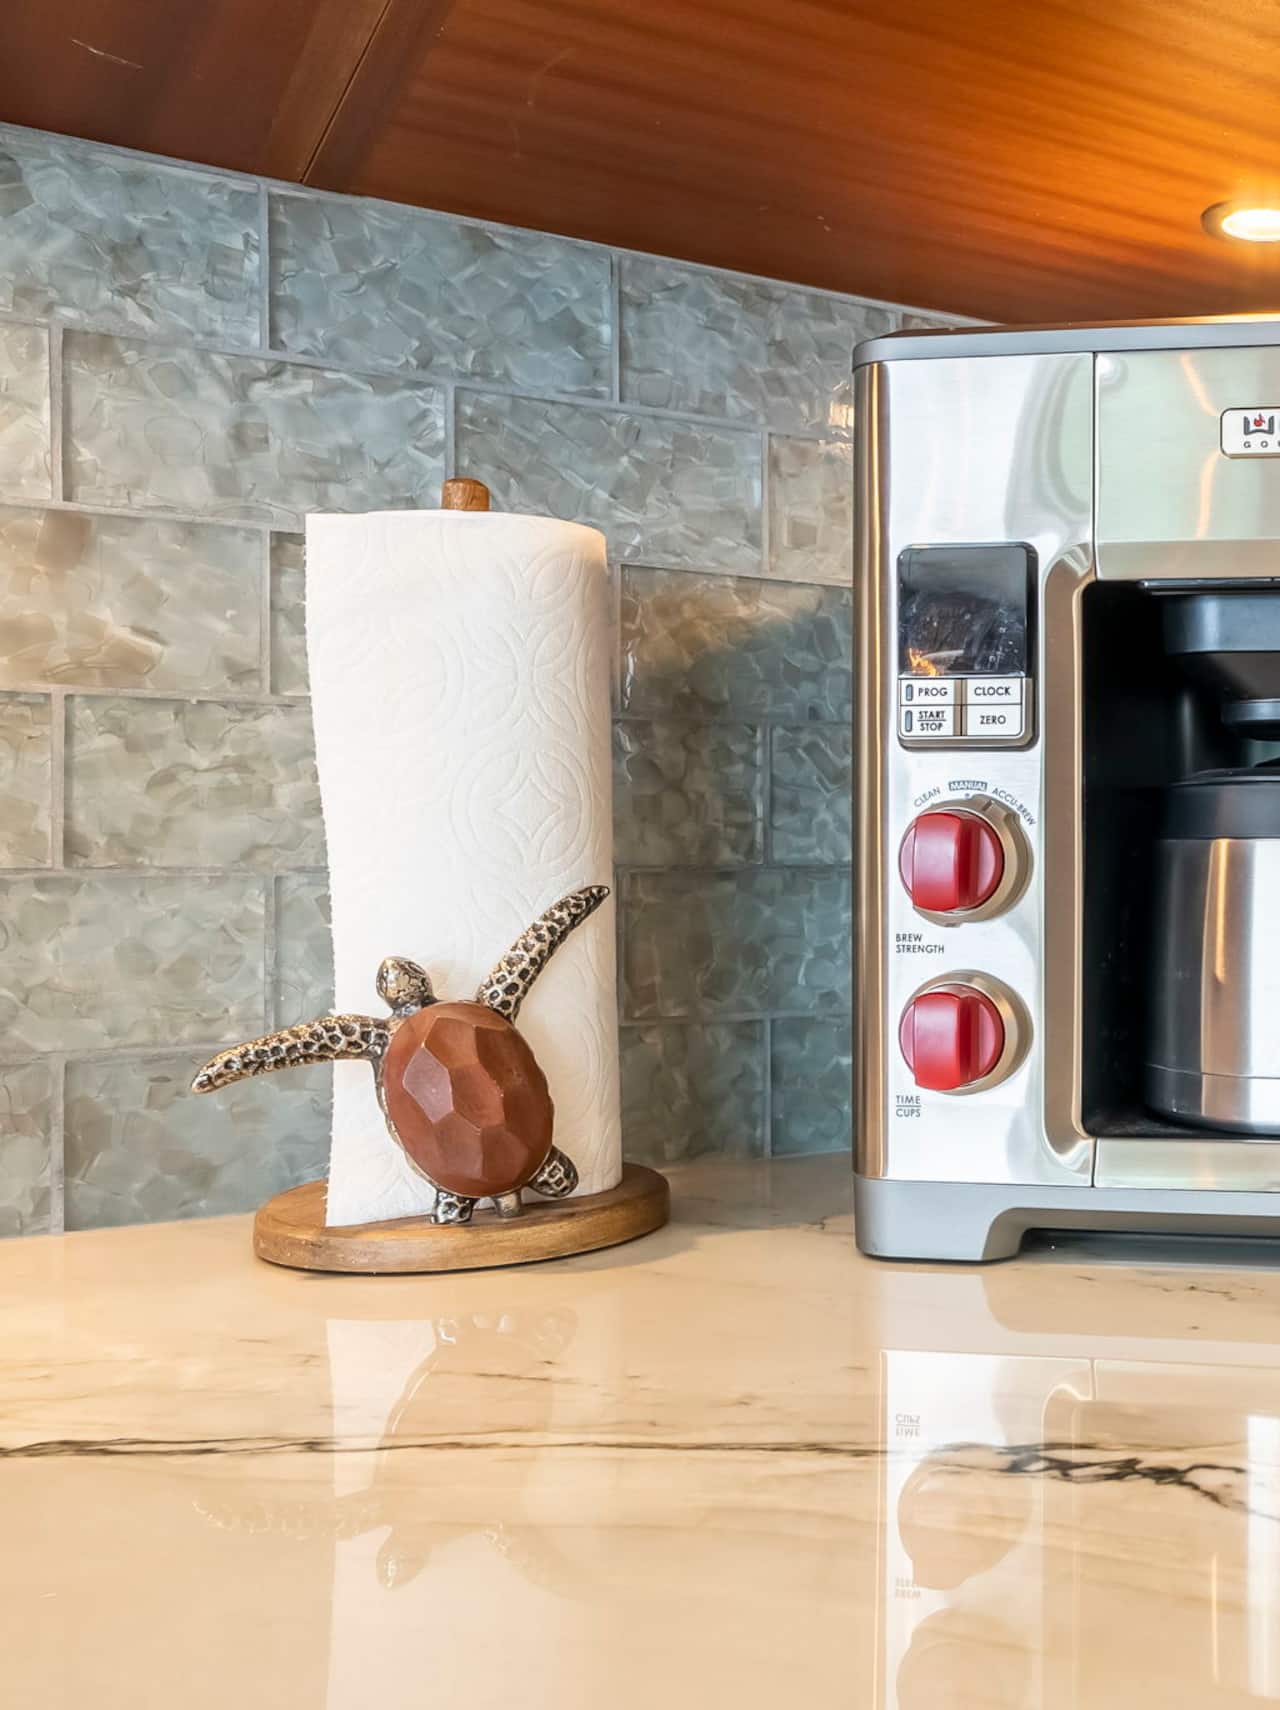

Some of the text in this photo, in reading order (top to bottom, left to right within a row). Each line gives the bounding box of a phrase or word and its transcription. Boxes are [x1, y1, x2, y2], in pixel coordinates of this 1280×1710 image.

[918, 687, 948, 697] PROG
[974, 686, 1011, 697] CLOCK
[918, 710, 945, 719] START
[980, 715, 1006, 725] ZERO
[919, 722, 943, 732] STOP
[949, 780, 987, 791] MANUAL
[914, 786, 941, 807] CLEAN
[991, 787, 1037, 826] ACCU-BREW
[895, 933, 922, 943] BREW
[895, 944, 945, 954] STRENGTH
[896, 1095, 921, 1105] TIME
[896, 1107, 921, 1118] CUPS
